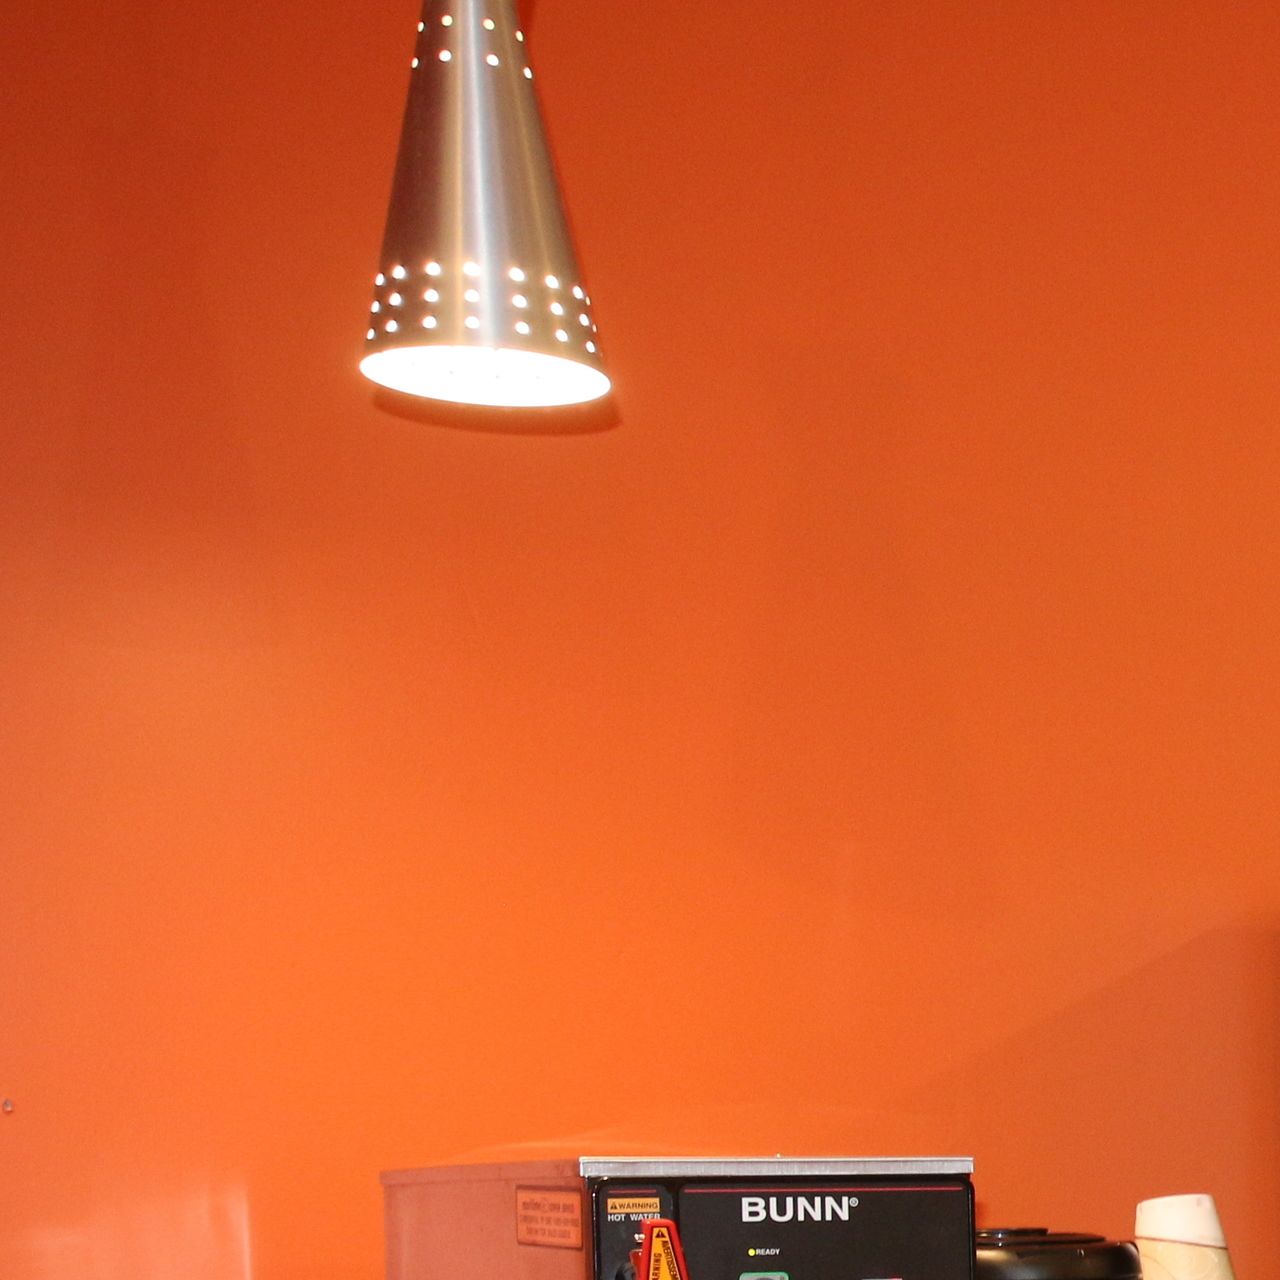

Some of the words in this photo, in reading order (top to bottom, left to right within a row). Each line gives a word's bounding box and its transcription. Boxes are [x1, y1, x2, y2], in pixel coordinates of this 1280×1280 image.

[619, 1201, 659, 1210] WARNING
[607, 1213, 626, 1222] HOT
[755, 1248, 780, 1256] READY
